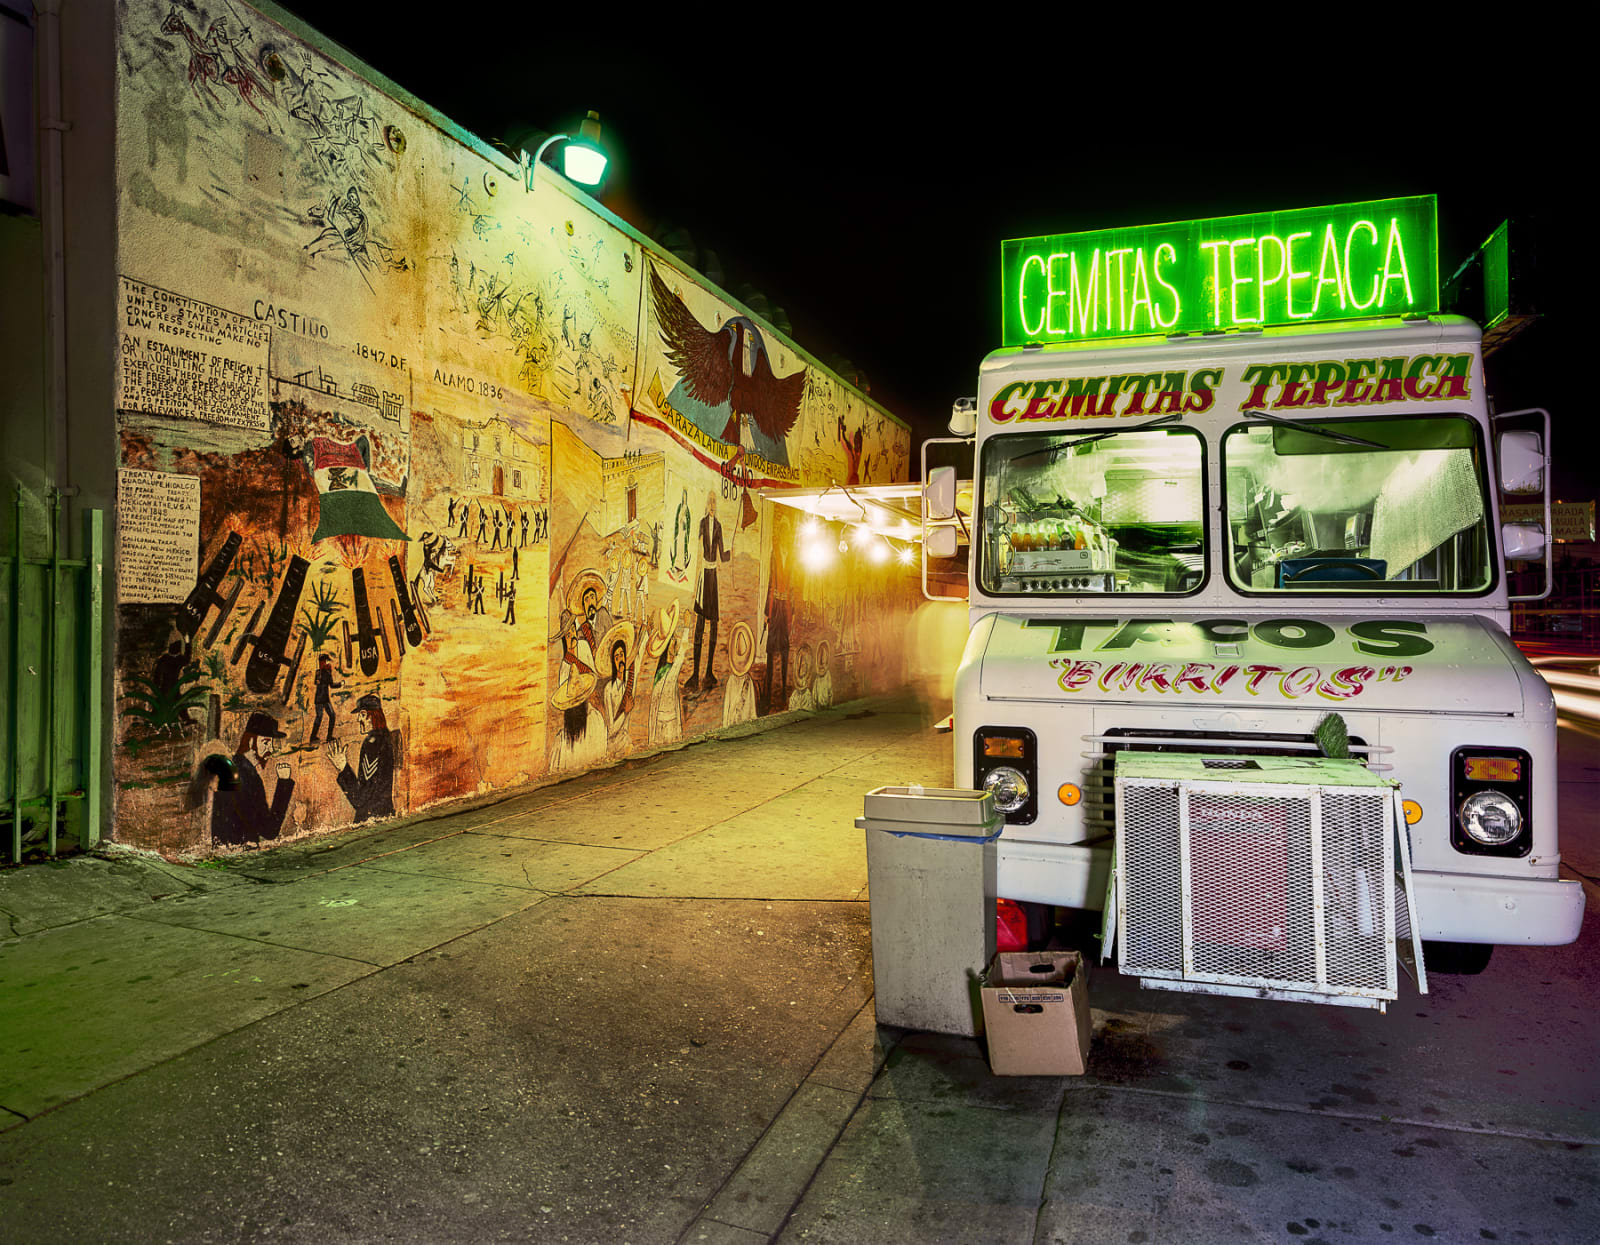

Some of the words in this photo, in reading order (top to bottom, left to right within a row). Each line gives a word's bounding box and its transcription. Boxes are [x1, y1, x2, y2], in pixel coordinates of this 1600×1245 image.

[1018, 243, 1182, 335] CEMITAS
[1200, 218, 1414, 327] TEPEACA
[124, 281, 146, 295] THE
[153, 290, 228, 319] CONSTITUTION
[232, 316, 246, 325] OF
[248, 319, 263, 331] THE
[127, 295, 168, 313] UNITED
[178, 308, 220, 326] STATES
[126, 305, 182, 325] CONGRESS
[188, 320, 214, 333] SHALL
[218, 329, 245, 343] MAKE
[247, 338, 261, 348] NO
[127, 316, 152, 330] LAW
[158, 322, 222, 345] RESPECTING
[122, 344, 137, 357] OR
[209, 364, 228, 379] THE
[233, 371, 261, 387] FREE
[123, 334, 140, 347] AN
[212, 355, 223, 368] OF
[123, 357, 171, 375] EXERCISE
[123, 367, 143, 380] THE
[123, 375, 142, 387] THE
[434, 368, 475, 393] ALAMO
[988, 366, 1226, 425] CEMITAS
[1238, 352, 1474, 412] TEPEACA
[702, 433, 729, 460] LATINA
[123, 470, 154, 480] TREATY
[1021, 617, 1435, 658] TACOS
[361, 646, 378, 660] USA
